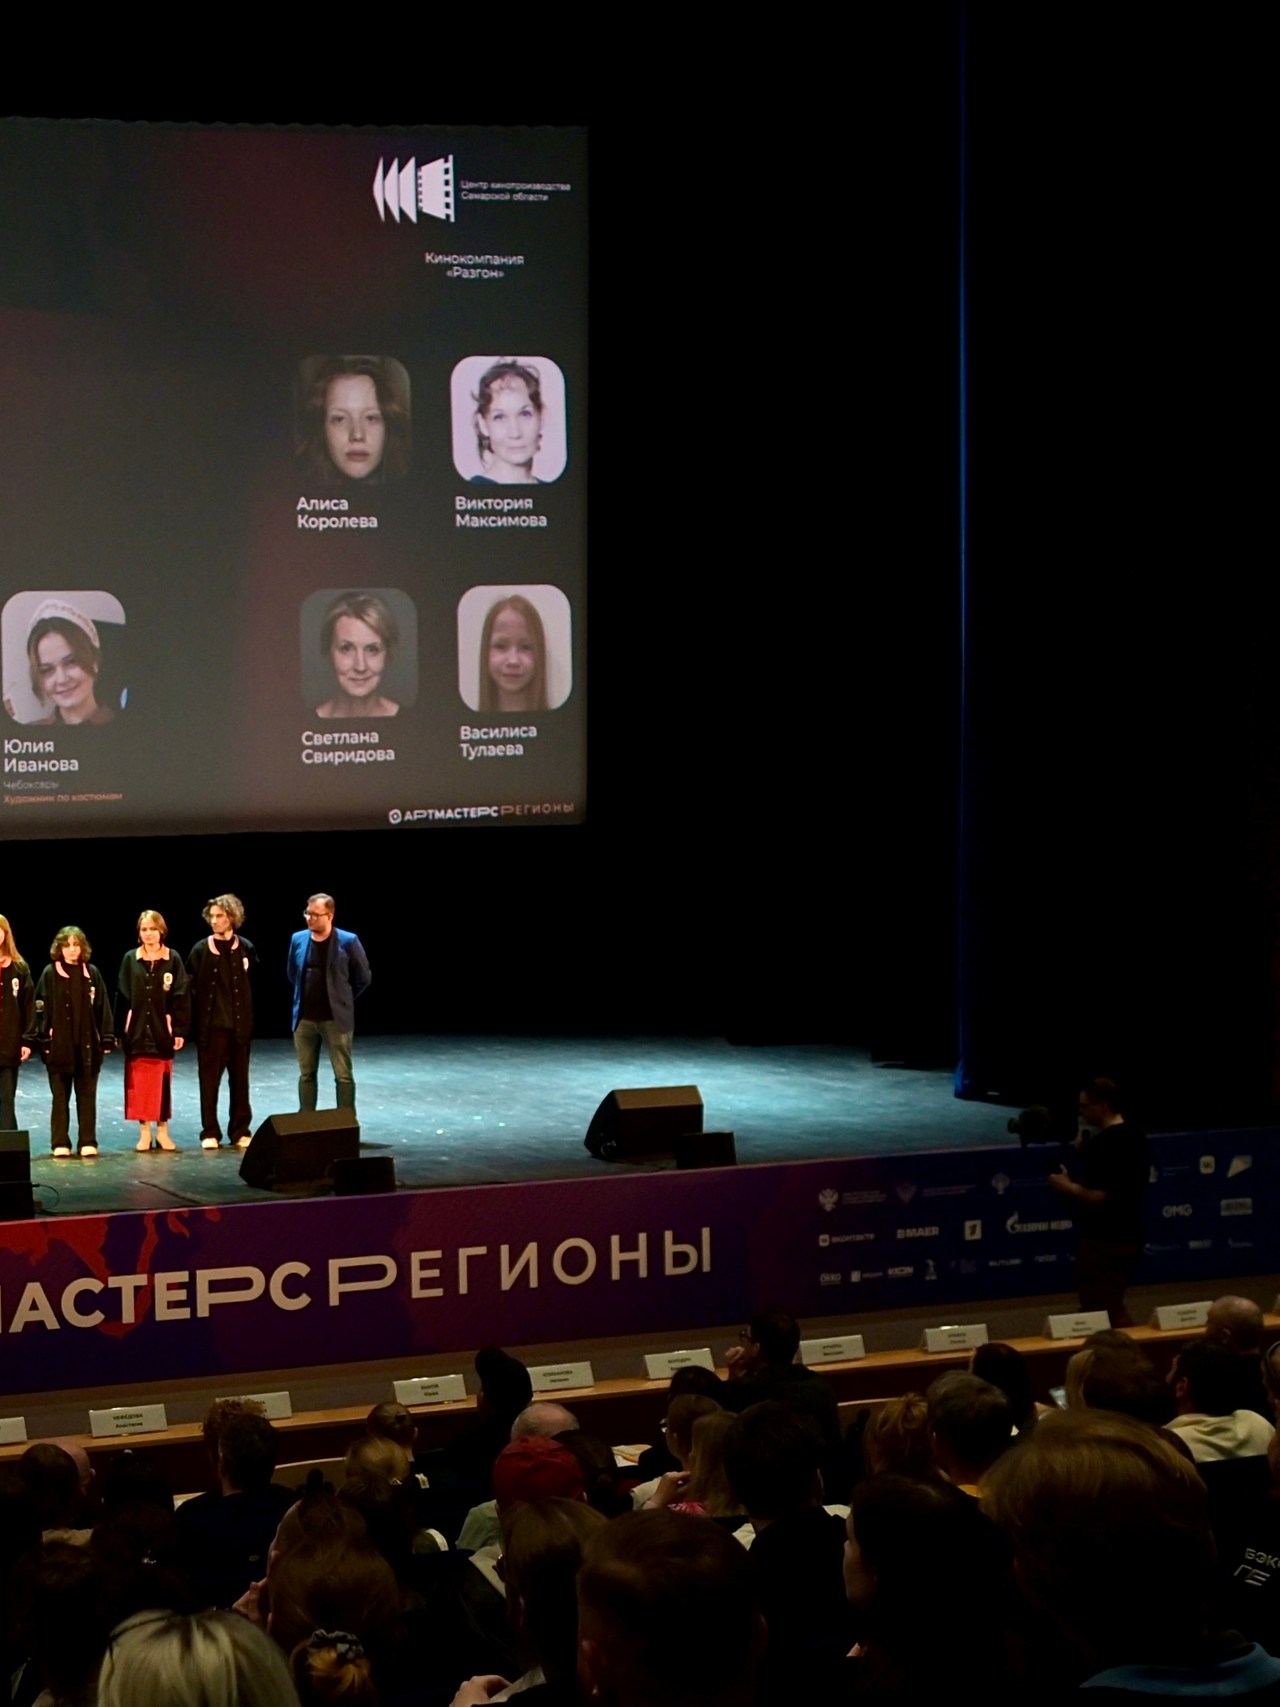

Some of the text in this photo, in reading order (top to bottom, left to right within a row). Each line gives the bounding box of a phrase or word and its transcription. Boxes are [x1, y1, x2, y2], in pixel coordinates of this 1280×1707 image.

[425, 253, 524, 265] Кинокомпания
[446, 266, 504, 278] «Разгон»
[296, 497, 349, 511] Алиса
[455, 496, 533, 513] Виктория
[297, 514, 378, 531] Королева
[455, 514, 548, 528] Максимова
[301, 731, 379, 746] Светлана
[460, 726, 537, 740] Василиса
[4, 739, 54, 754] Юлия
[460, 743, 524, 760] Тулаева
[301, 748, 395, 765] Свиридова
[4, 758, 79, 772] Иванова
[404, 803, 574, 822] АРТМАСТЕРС РЕГИОНЫ
[327, 1227, 711, 1307] РЕГИОНЫ
